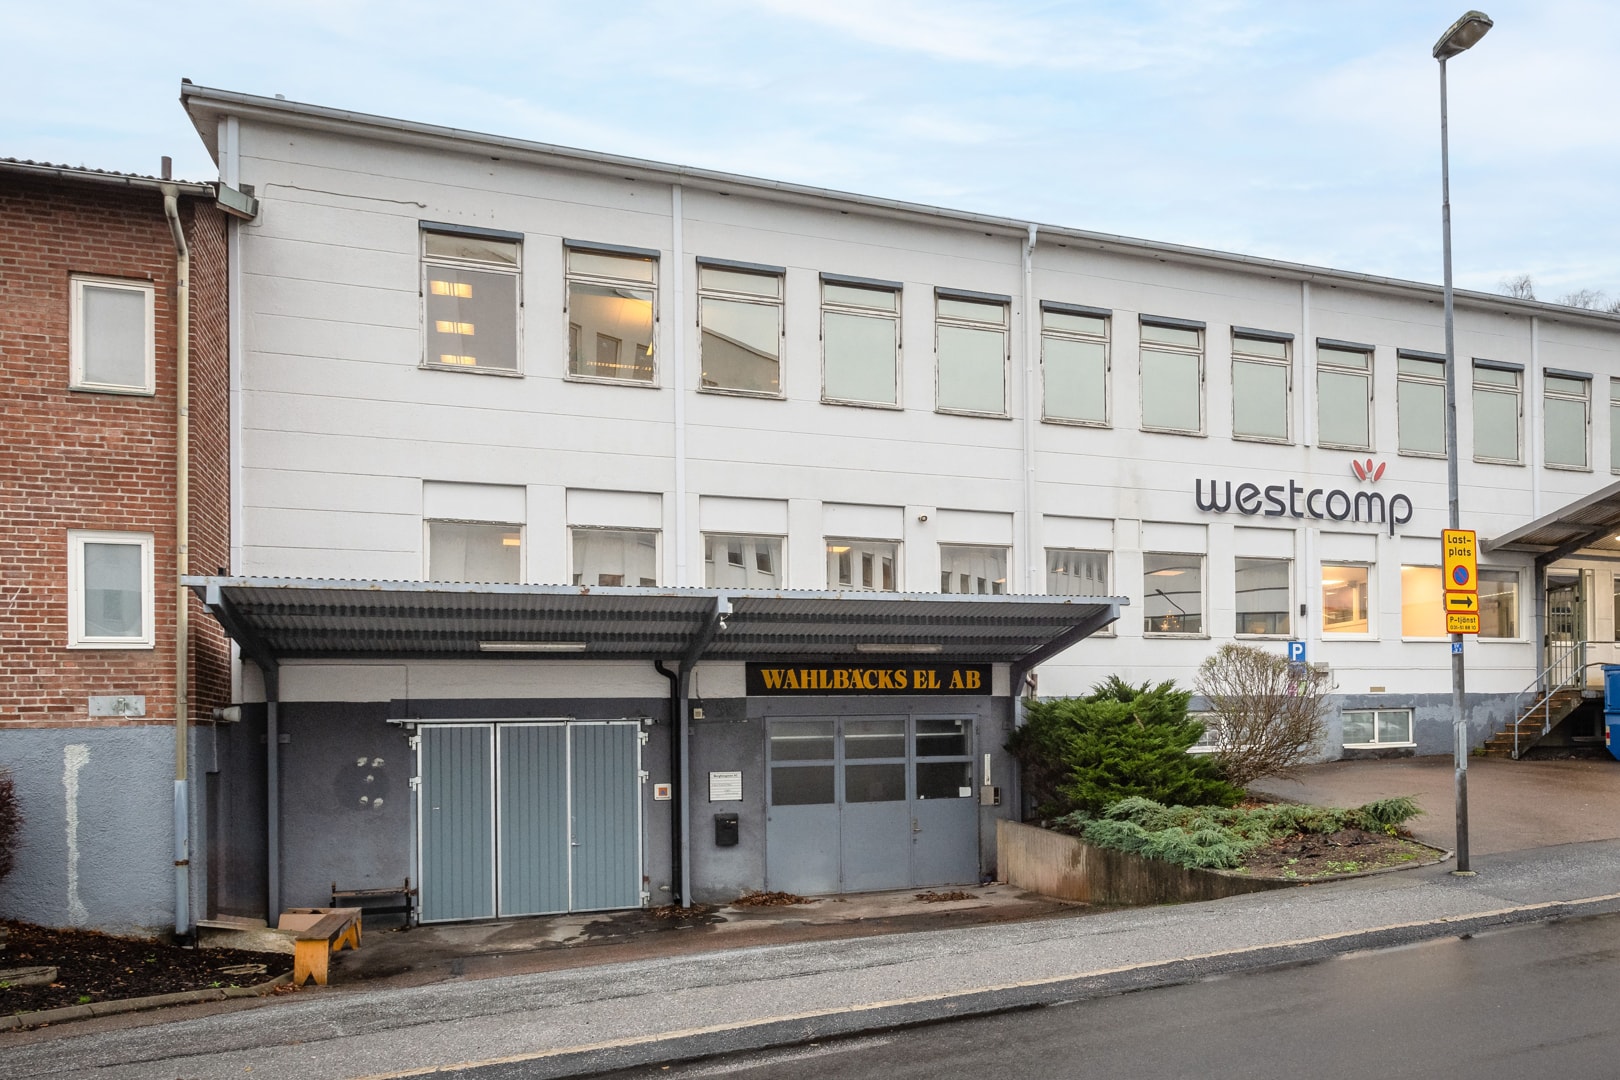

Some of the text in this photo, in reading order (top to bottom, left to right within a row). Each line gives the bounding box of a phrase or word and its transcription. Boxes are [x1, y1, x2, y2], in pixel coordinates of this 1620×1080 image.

[1195, 478, 1413, 537] westcomp
[1447, 534, 1472, 544] Last-
[1448, 546, 1472, 557] plats
[1292, 643, 1304, 661] P
[761, 668, 982, 690] WAHLBÄCKS EL AB
